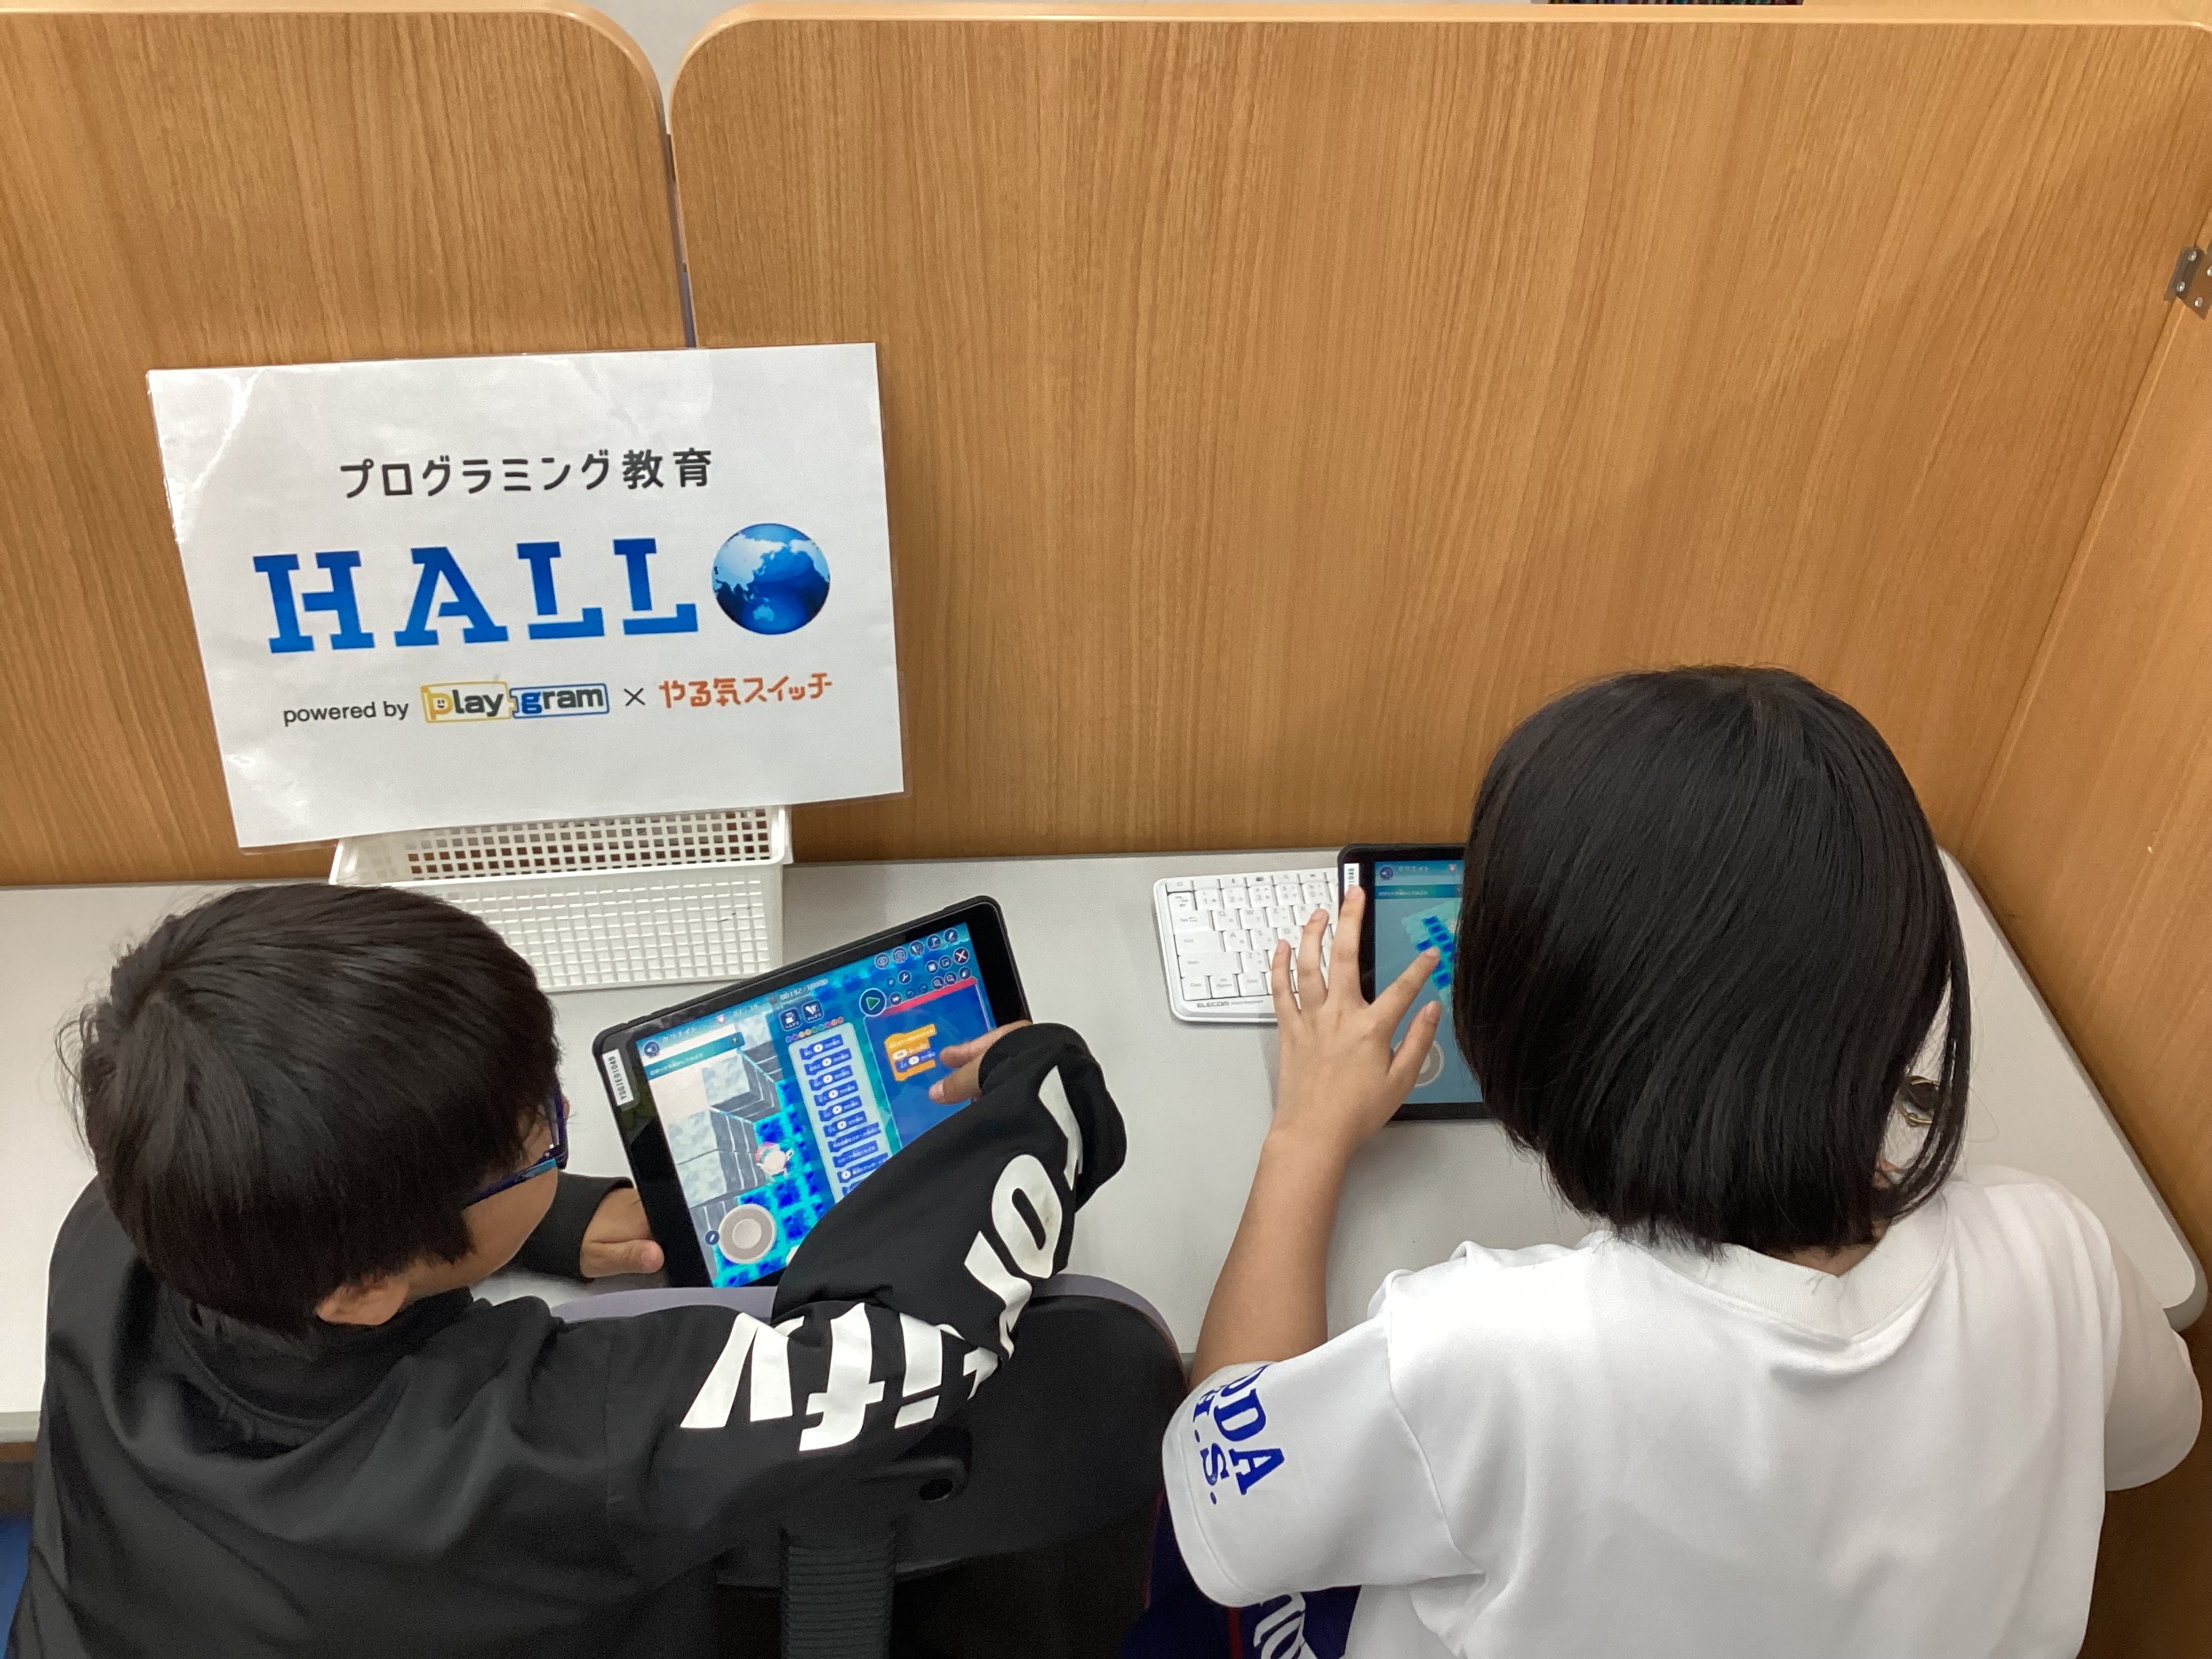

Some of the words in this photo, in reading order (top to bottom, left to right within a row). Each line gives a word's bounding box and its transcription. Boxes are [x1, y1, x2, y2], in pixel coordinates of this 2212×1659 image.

[340, 447, 711, 498] プログラミング教育
[283, 701, 377, 726] powered
[384, 701, 409, 720] by
[659, 672, 833, 709] やる気スイッチ
